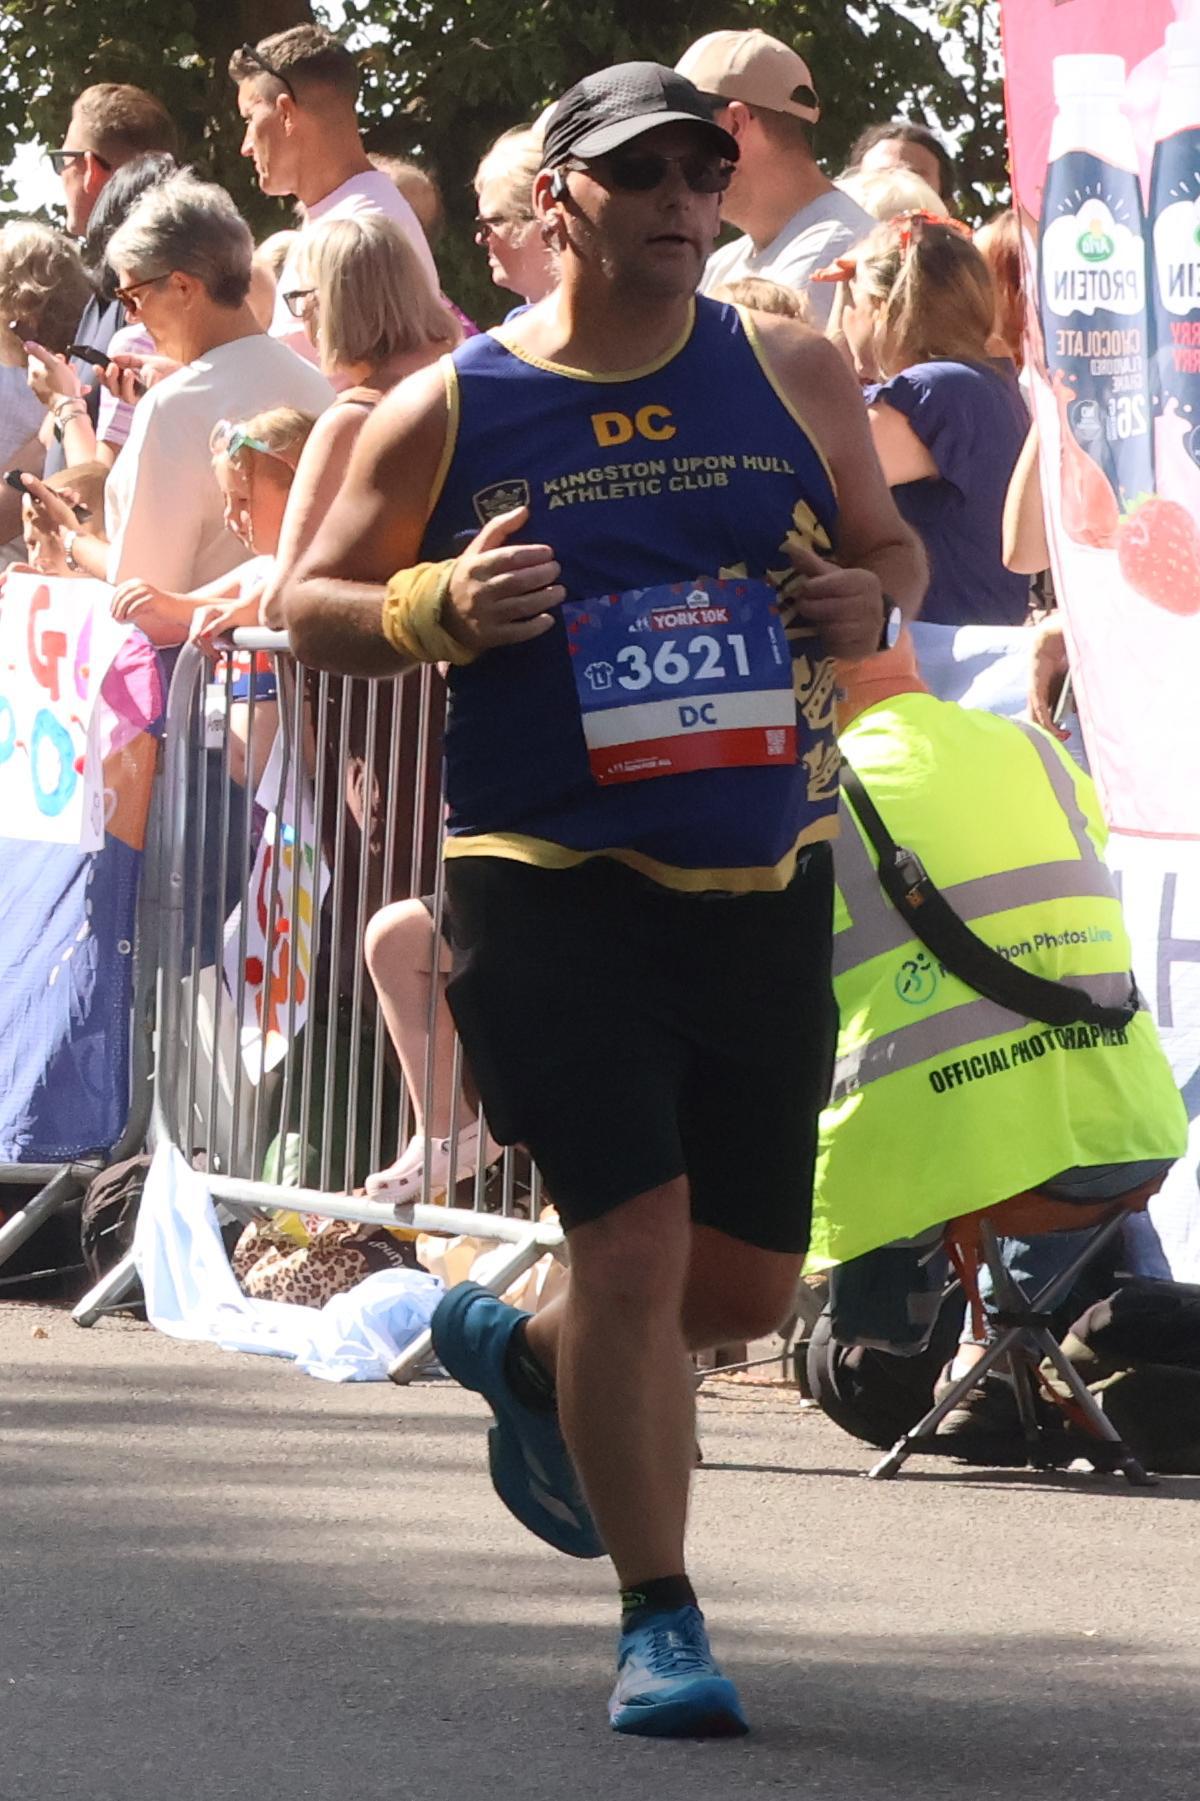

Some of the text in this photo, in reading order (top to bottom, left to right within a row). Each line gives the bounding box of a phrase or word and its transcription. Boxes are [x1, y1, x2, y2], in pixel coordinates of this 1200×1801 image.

[591, 404, 677, 448] DC
[543, 455, 796, 495] KINGSTON UPON HULL
[548, 471, 729, 511] ATHLETIC CLUB
[653, 611, 699, 630] YORK
[701, 608, 730, 624] 10K
[616, 634, 751, 691] 3621
[678, 703, 718, 728] DC
[1033, 926, 1113, 950] Photos Live
[928, 1046, 1011, 1094] OFFICIAL
